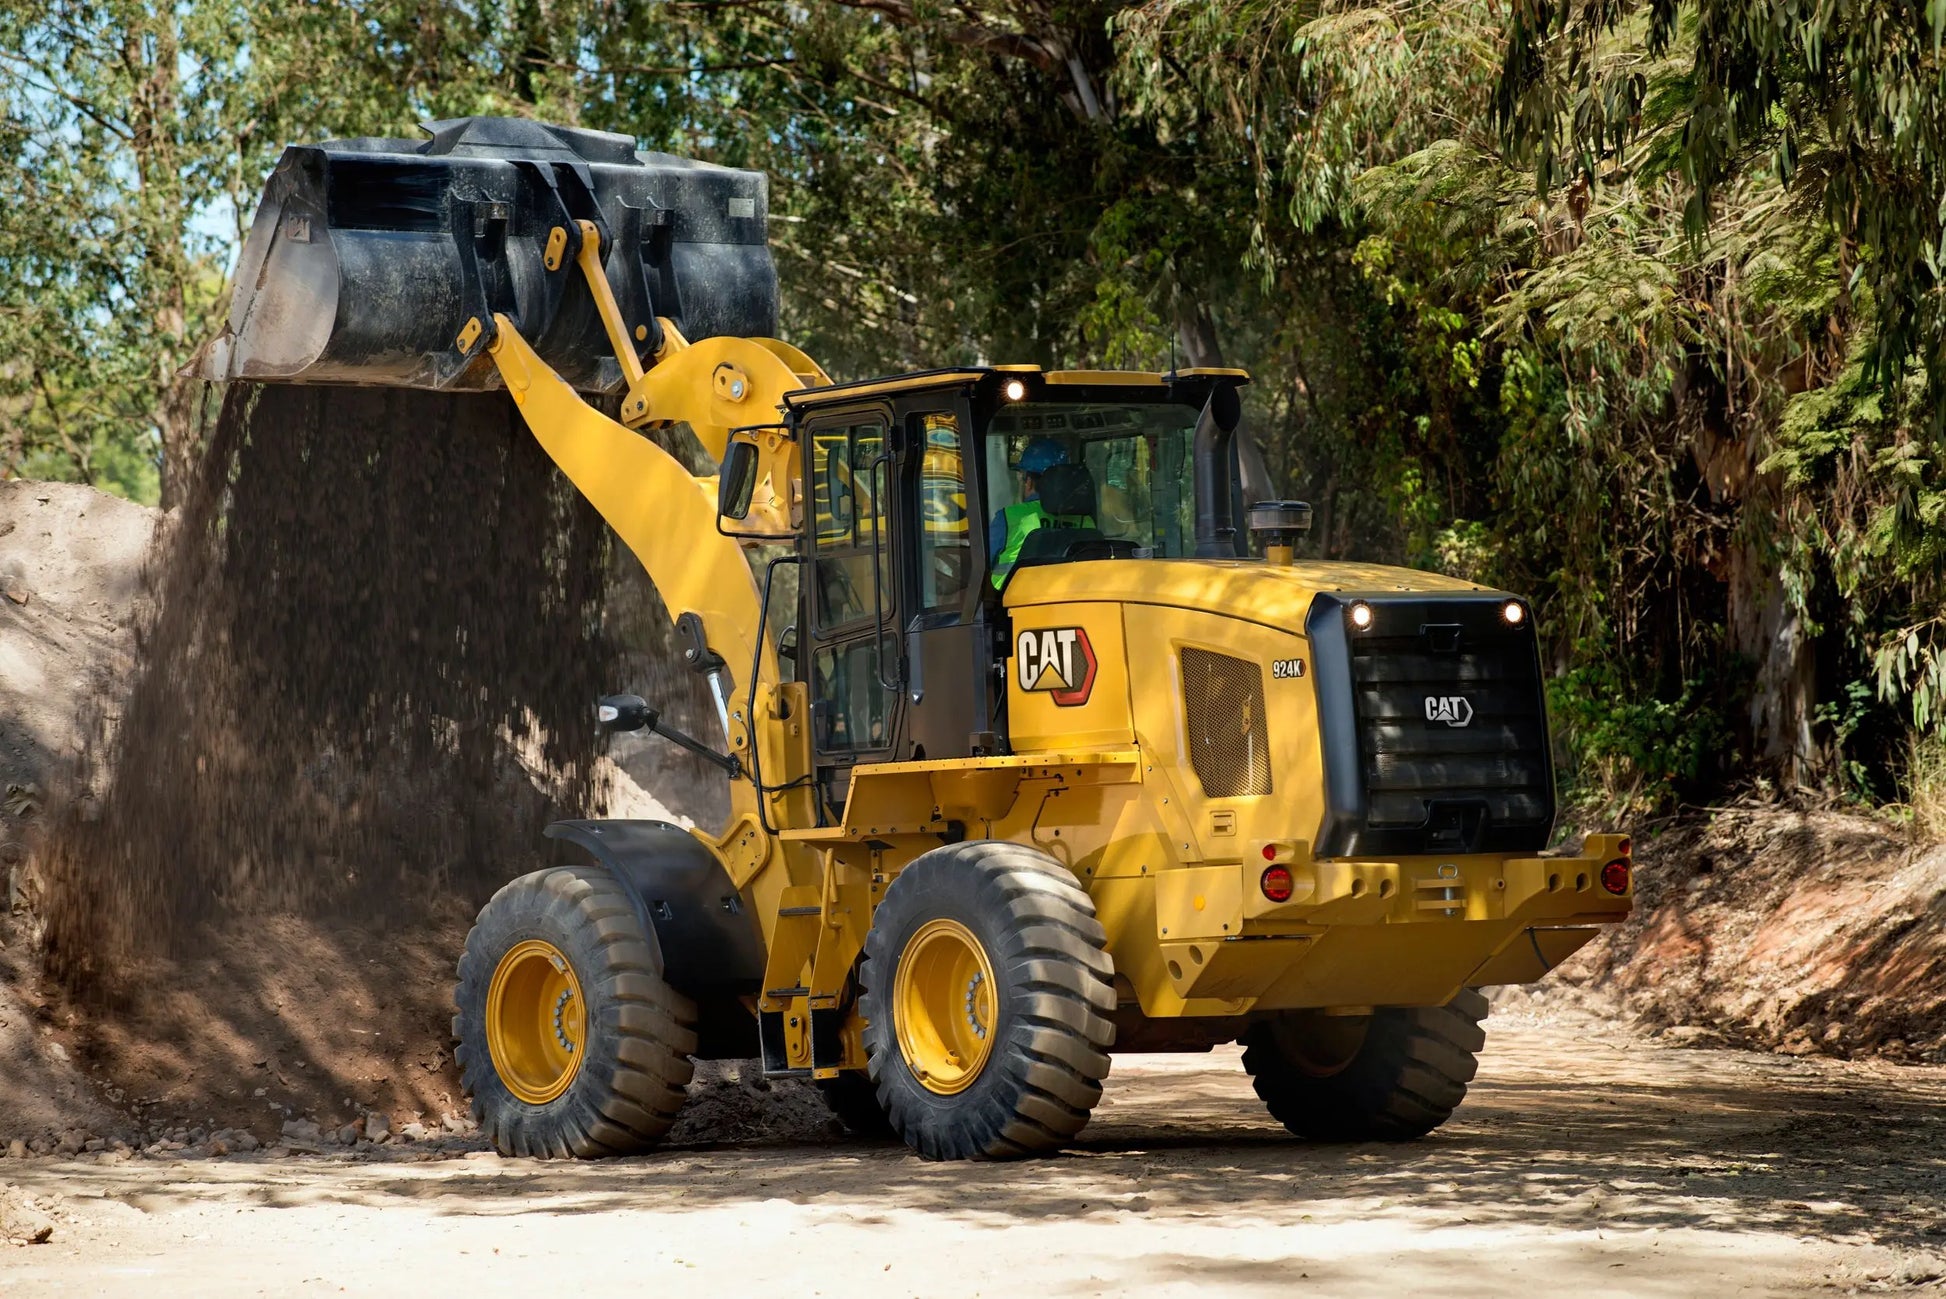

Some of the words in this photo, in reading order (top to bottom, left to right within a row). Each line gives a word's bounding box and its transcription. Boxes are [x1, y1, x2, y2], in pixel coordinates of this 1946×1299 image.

[1018, 629, 1076, 690] CAT
[1273, 660, 1301, 678] 924K
[1425, 696, 1461, 721] CAT
